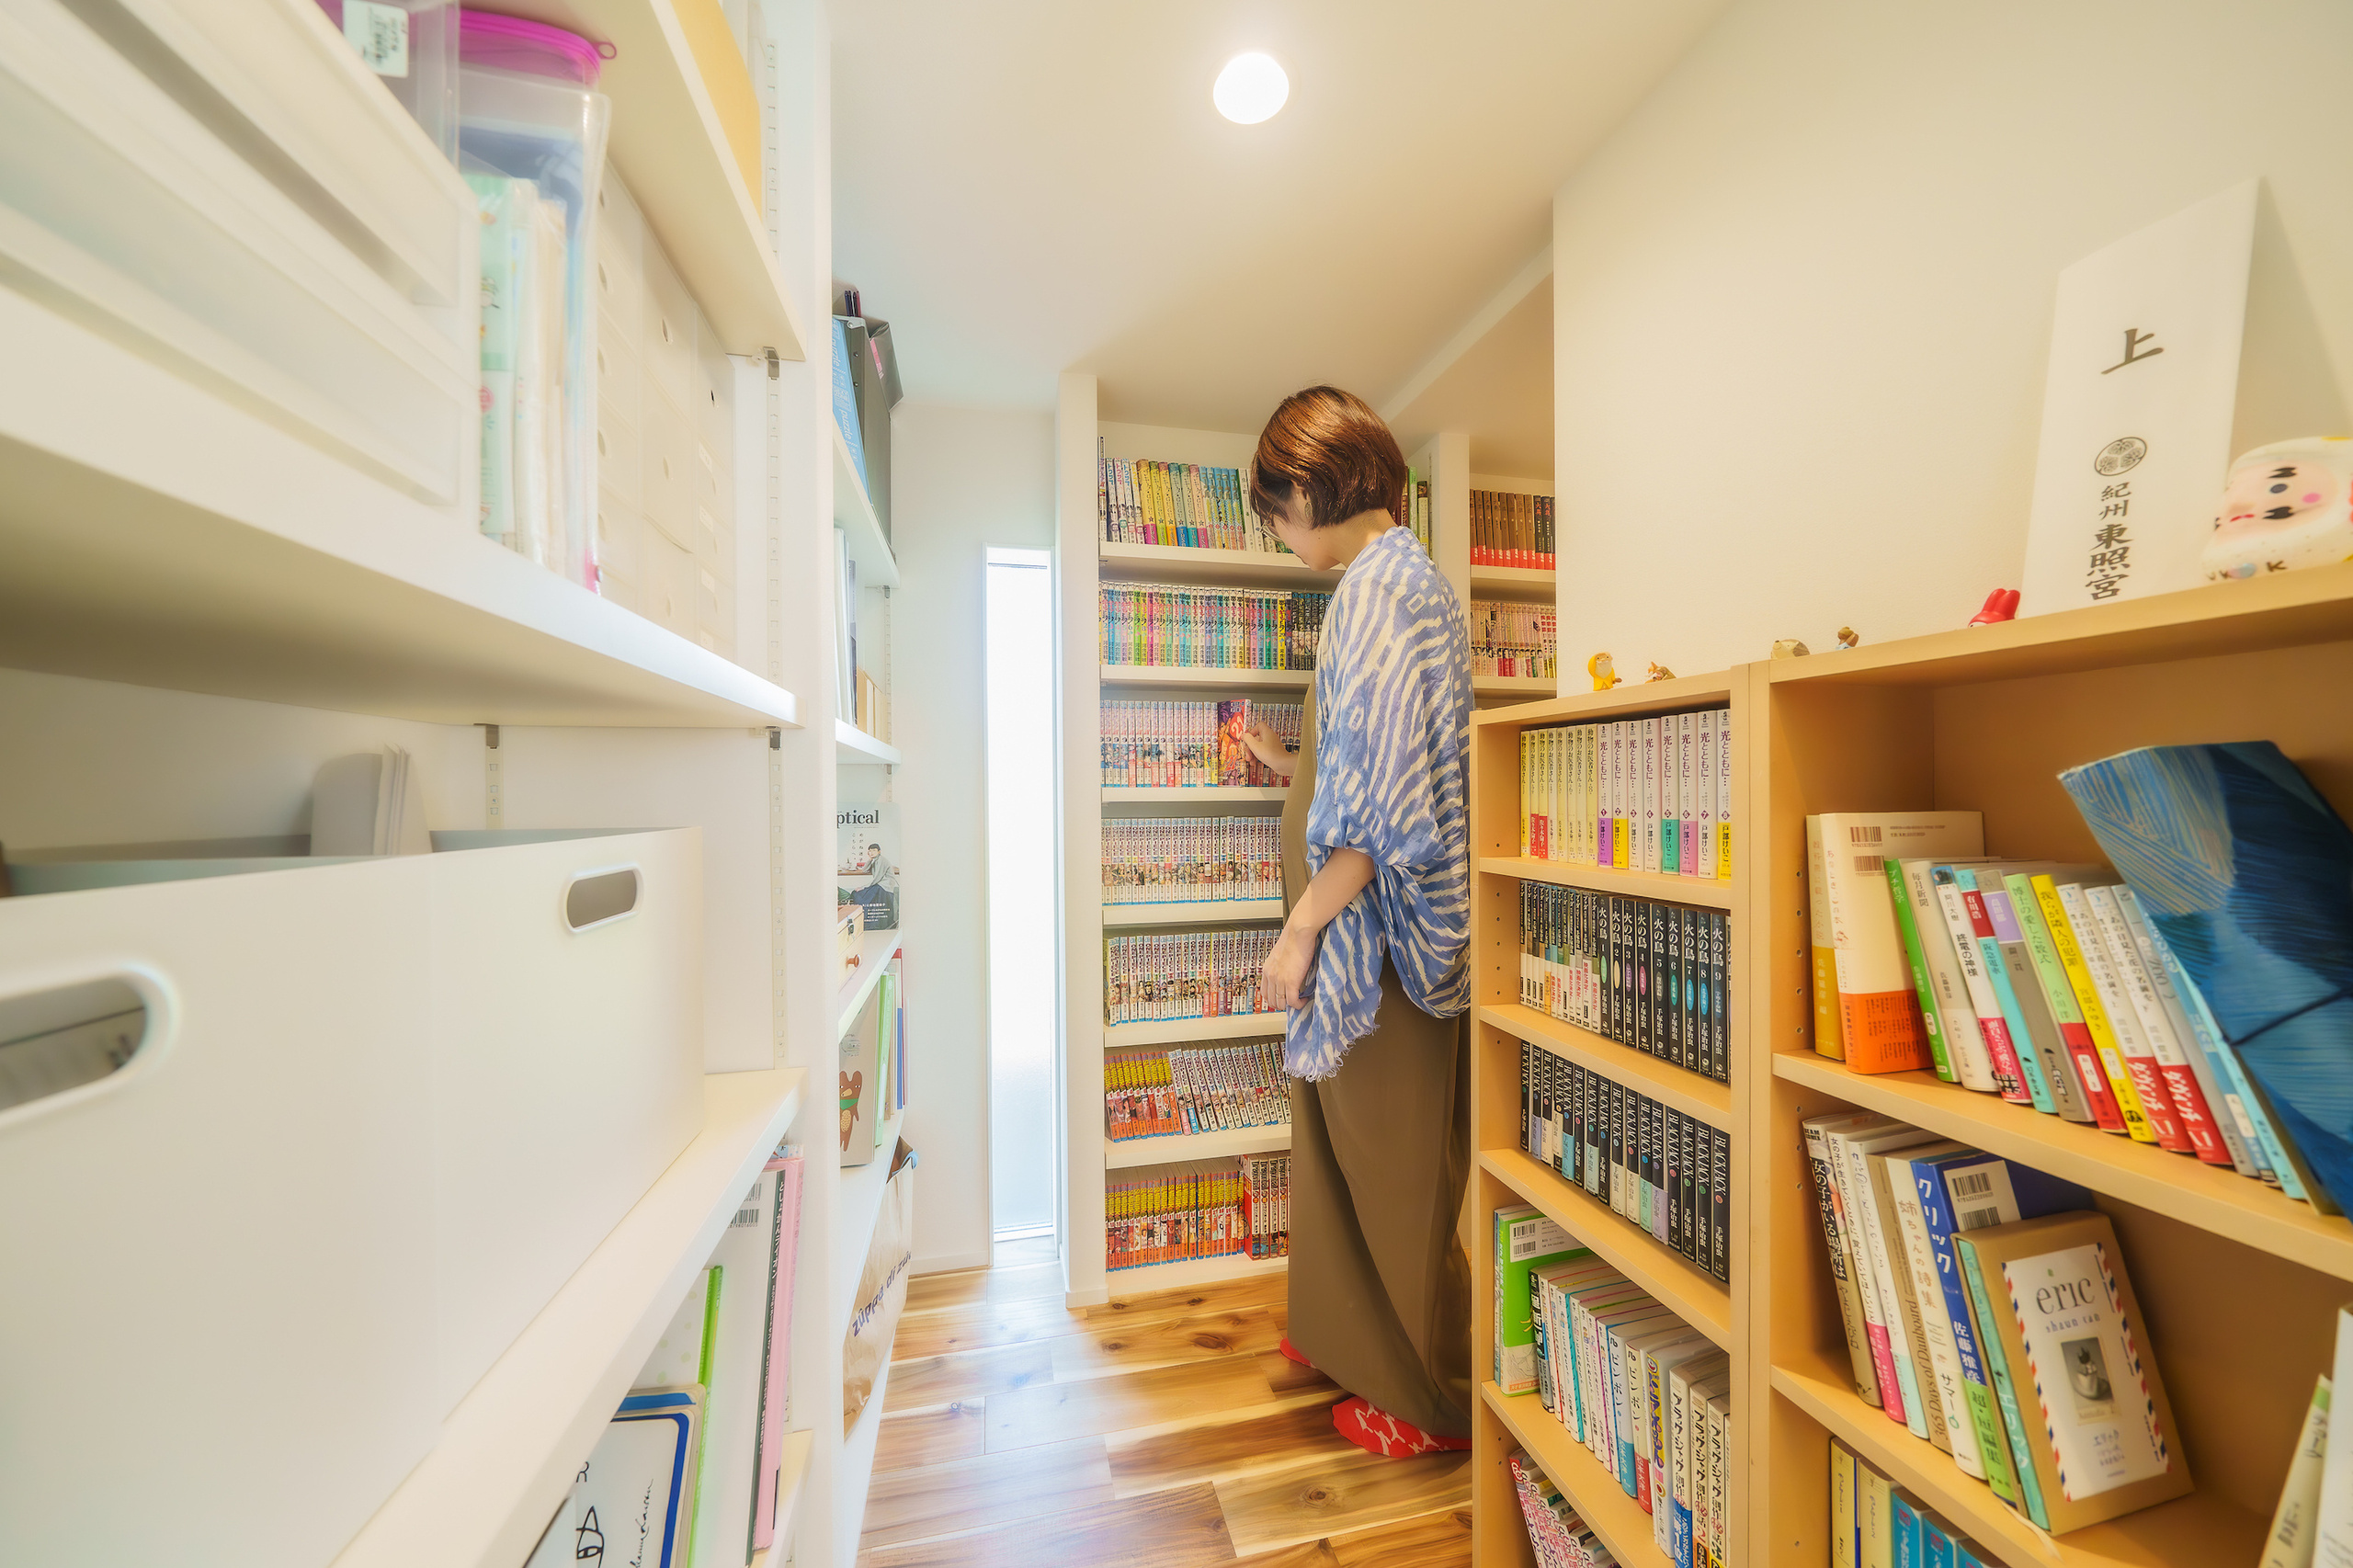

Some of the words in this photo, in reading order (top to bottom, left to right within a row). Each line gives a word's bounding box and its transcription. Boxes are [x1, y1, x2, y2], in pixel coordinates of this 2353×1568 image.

[2100, 327, 2165, 375] 上
[2085, 482, 2133, 600] 紀州東照宮
[1888, 869, 1904, 903] プチ哲学
[1912, 872, 1929, 907] 毎月新聞
[1945, 894, 1960, 921] 阿川大樹
[1967, 895, 1982, 919] 有川浩
[2013, 886, 2052, 964] 博士の愛した数式
[1612, 912, 1620, 945] 火の鳥
[1624, 913, 1633, 947] 火の鳥
[1638, 915, 1647, 949] 火の鳥
[1654, 918, 1665, 954] 火の鳥
[1669, 920, 1678, 957] 火の鳥
[1684, 925, 1695, 961] 火の鳥
[1699, 926, 1710, 964] 火の鳥
[2040, 891, 2078, 967] 我らが隣人の犯罪
[1614, 949, 1619, 957] 2
[1626, 950, 1631, 959] 3
[1640, 952, 1644, 961] 4
[1656, 959, 1662, 968] 5
[1670, 960, 1677, 971] 6
[1713, 928, 1723, 967] 火の鳥
[1956, 933, 1978, 976] 終電の神様
[1984, 943, 2001, 975] 阪急電車
[1688, 965, 1692, 975] 7
[1700, 969, 1707, 979] 8
[1715, 971, 1722, 981] 9
[2078, 988, 2101, 1030] 宮部みゆき
[1813, 1162, 1846, 1279] 女の子がいる場所は
[1918, 1178, 1950, 1273] クリック
[1899, 1199, 1938, 1309] 姉ちゃんの詩集
[886, 1266, 896, 1289] di
[2036, 1277, 2096, 1315] eric
[1906, 1299, 1927, 1362] Danboard
[2046, 1319, 2079, 1333] shaun
[1953, 1320, 1982, 1385] 佐藤雅彦
[1611, 1353, 1622, 1406] ピンポン
[1629, 1366, 1640, 1421] ピンポン
[1927, 1380, 1942, 1416] Days
[1999, 1392, 2029, 1469] エリック
